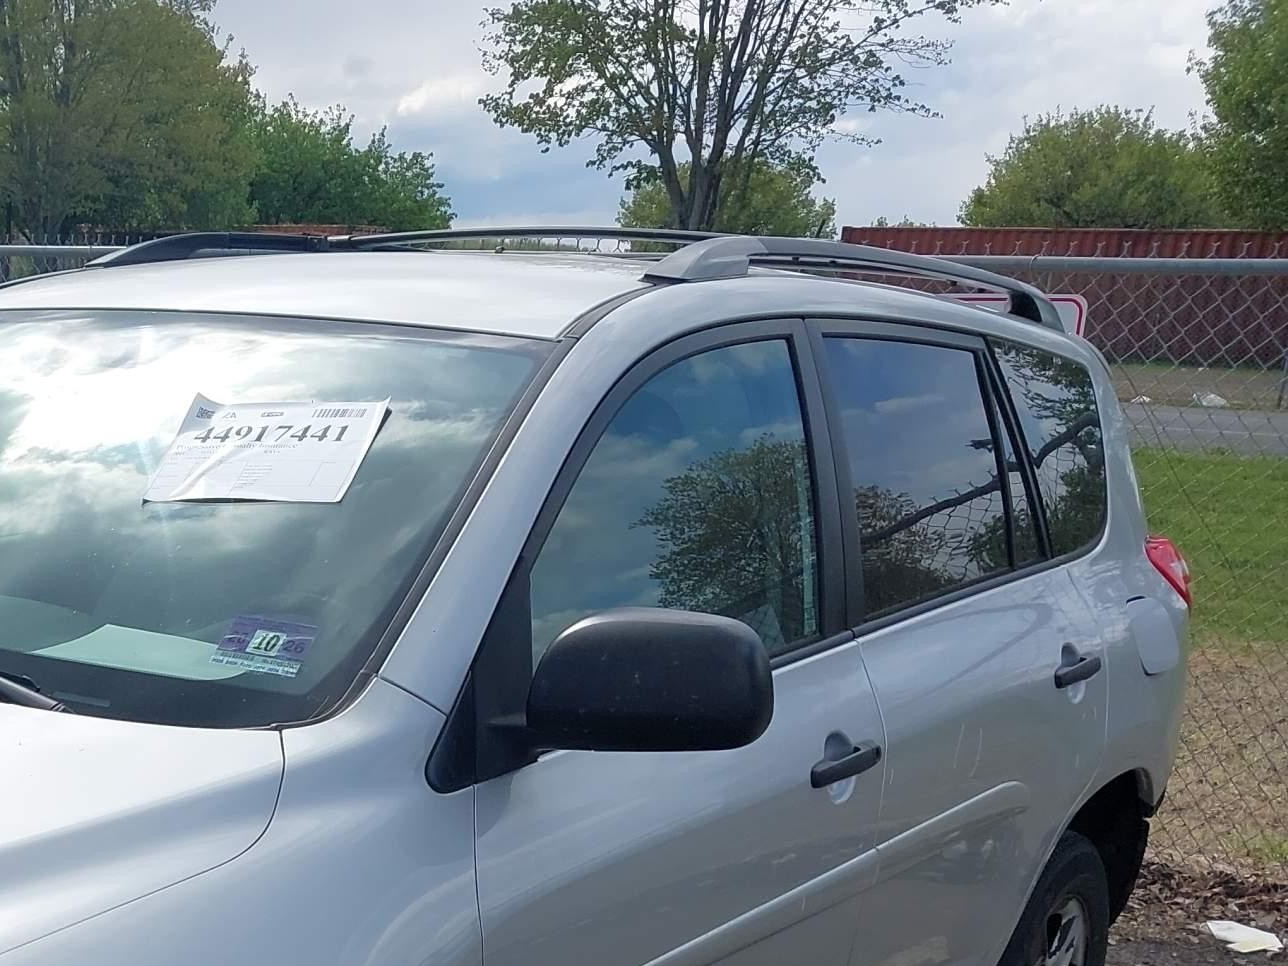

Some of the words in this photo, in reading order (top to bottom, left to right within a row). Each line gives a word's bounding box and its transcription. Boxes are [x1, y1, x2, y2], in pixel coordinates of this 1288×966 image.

[193, 424, 350, 443] 44917441
[252, 634, 281, 652] 10
[283, 640, 305, 654] 26
